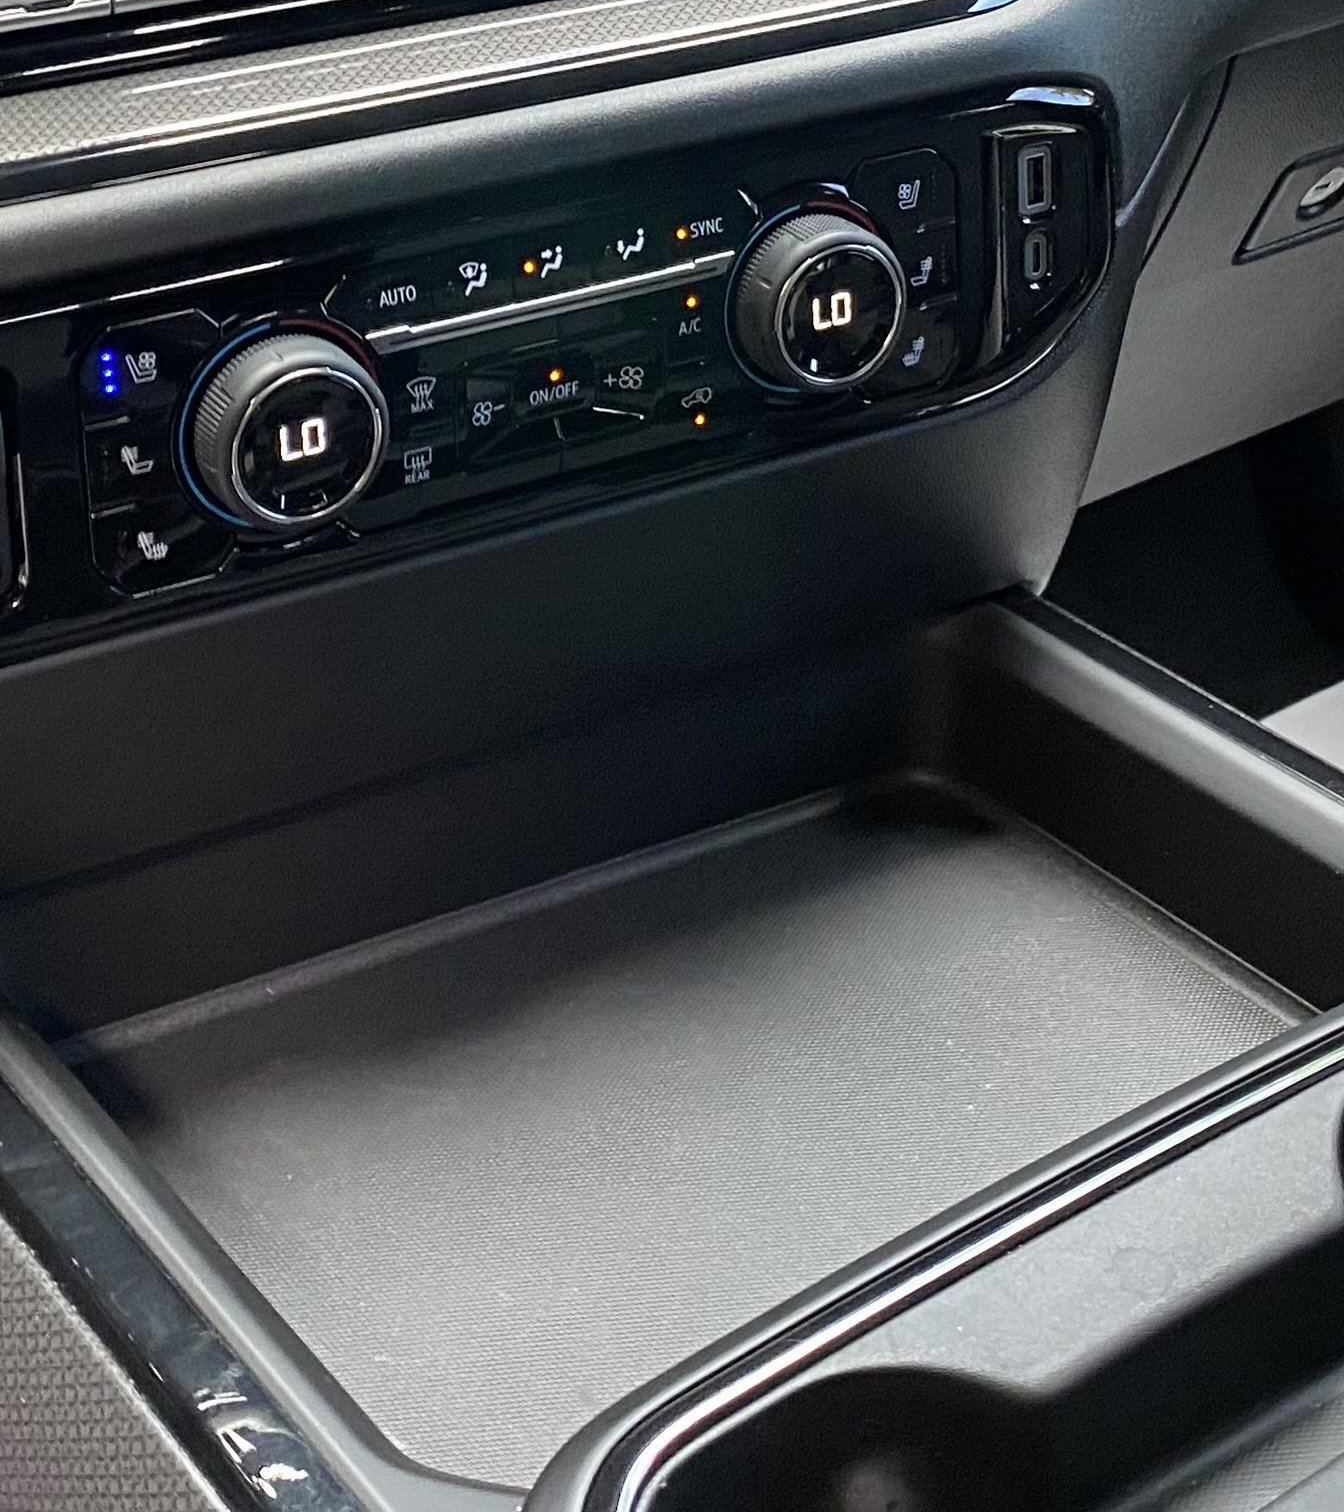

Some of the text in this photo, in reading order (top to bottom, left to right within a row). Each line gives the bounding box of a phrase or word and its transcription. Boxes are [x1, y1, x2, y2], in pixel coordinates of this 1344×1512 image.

[689, 217, 724, 239] SYNC
[379, 285, 417, 308] AUTO
[812, 291, 852, 331] LO
[678, 317, 701, 336] A/C
[529, 380, 579, 406] ON/OFF
[411, 398, 434, 413] MAX
[280, 418, 326, 462] LO
[405, 468, 430, 484] REAR
